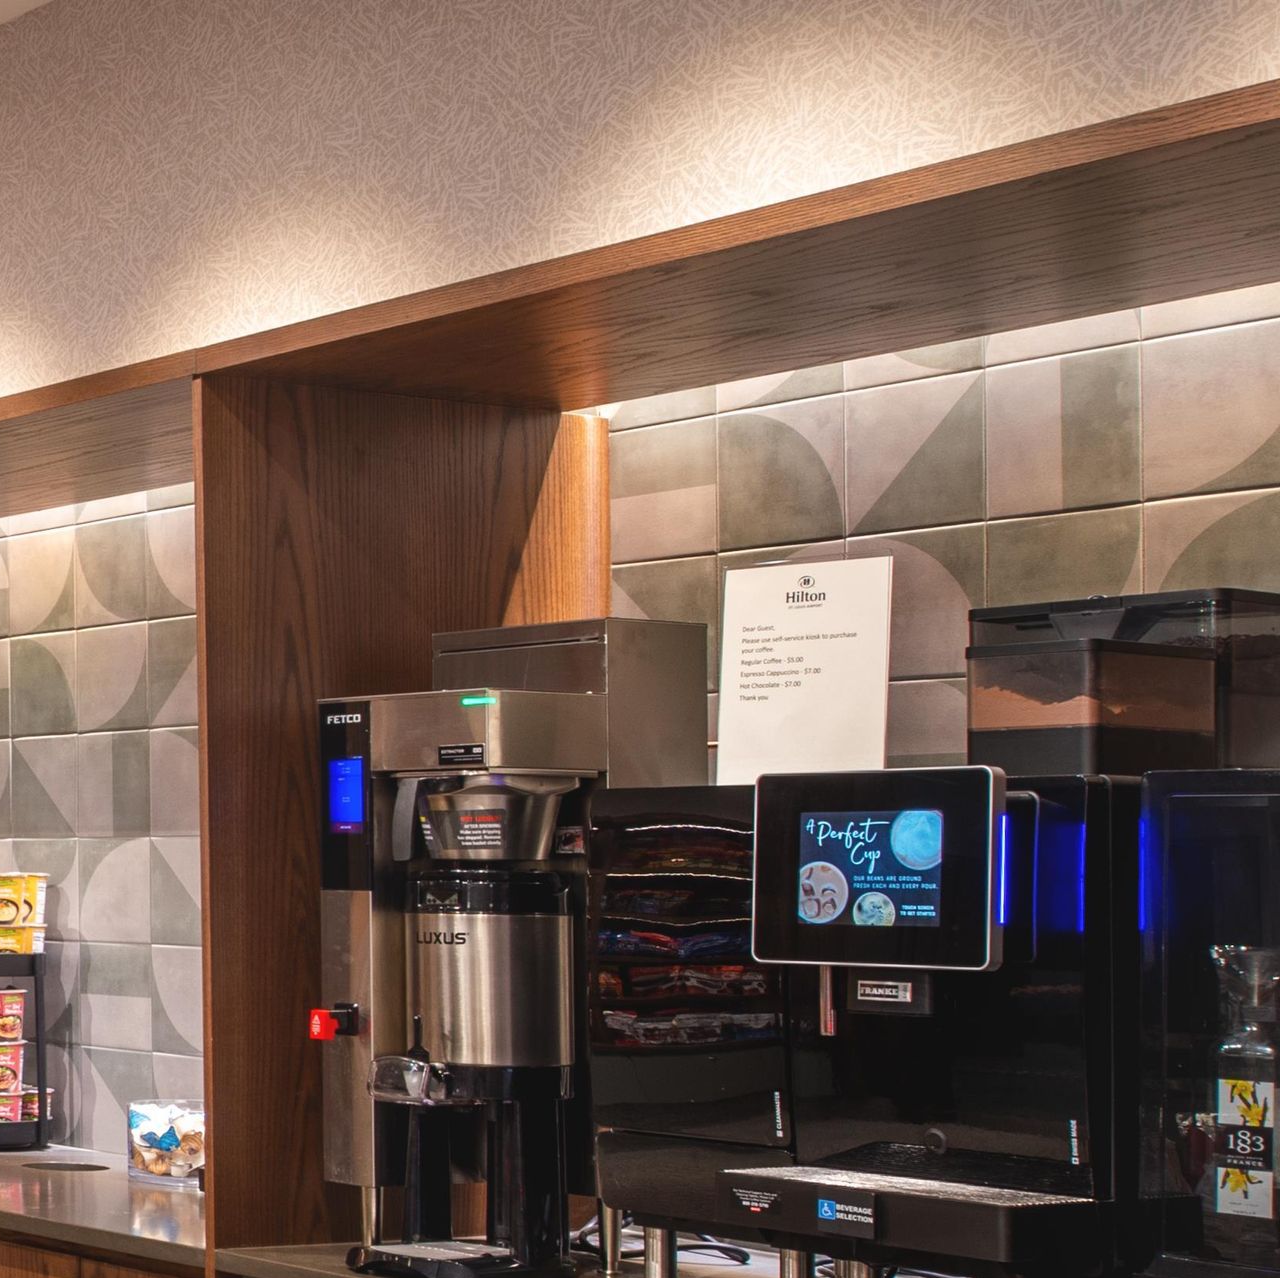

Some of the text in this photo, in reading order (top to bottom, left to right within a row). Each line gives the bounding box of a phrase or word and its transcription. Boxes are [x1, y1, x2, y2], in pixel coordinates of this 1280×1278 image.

[786, 591, 826, 604] Hilton
[742, 625, 756, 633] Dear
[742, 637, 760, 645] Please
[772, 634, 804, 643] self-service
[805, 633, 821, 641] kiosk
[829, 631, 858, 640] purchase
[741, 647, 754, 655] your
[741, 658, 762, 667] Regular
[763, 656, 782, 664] Coffee
[740, 667, 821, 679] Espresso Cappuccino $7.00
[751, 681, 780, 689] Chocolate
[784, 680, 802, 688] $7.00
[758, 694, 769, 703] you
[327, 713, 361, 725] FETCO
[806, 818, 891, 849] A Perfect
[850, 842, 881, 874] Cup
[415, 931, 467, 945] LUXUS
[859, 985, 899, 996] FRANKE
[1227, 1159, 1263, 1167] FRANCE
[836, 1204, 872, 1215] BEVERAGE
[836, 1212, 873, 1224] SELECTION
